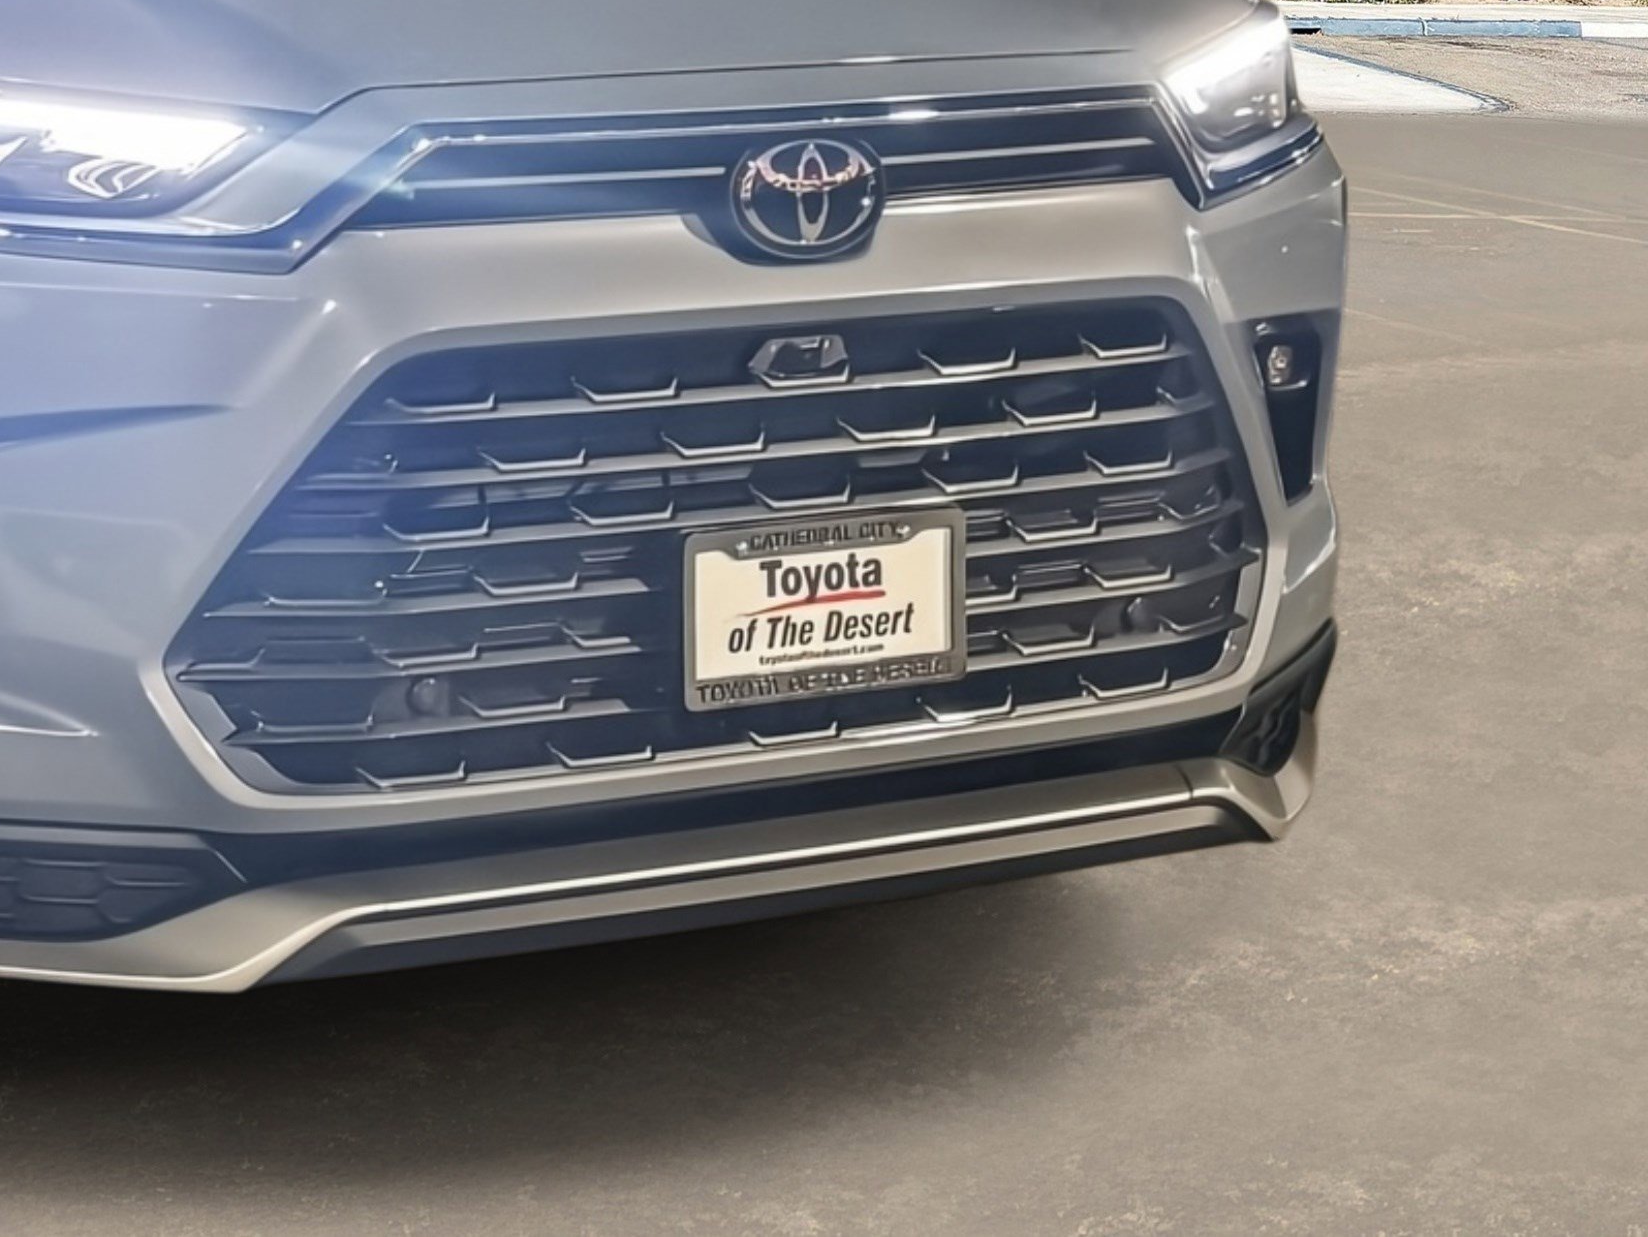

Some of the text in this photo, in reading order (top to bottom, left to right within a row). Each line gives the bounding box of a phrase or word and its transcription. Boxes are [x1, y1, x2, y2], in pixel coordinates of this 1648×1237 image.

[750, 523, 852, 551] CATHEDRAL
[759, 552, 883, 602] Toyota
[728, 602, 915, 653] of The Desert
